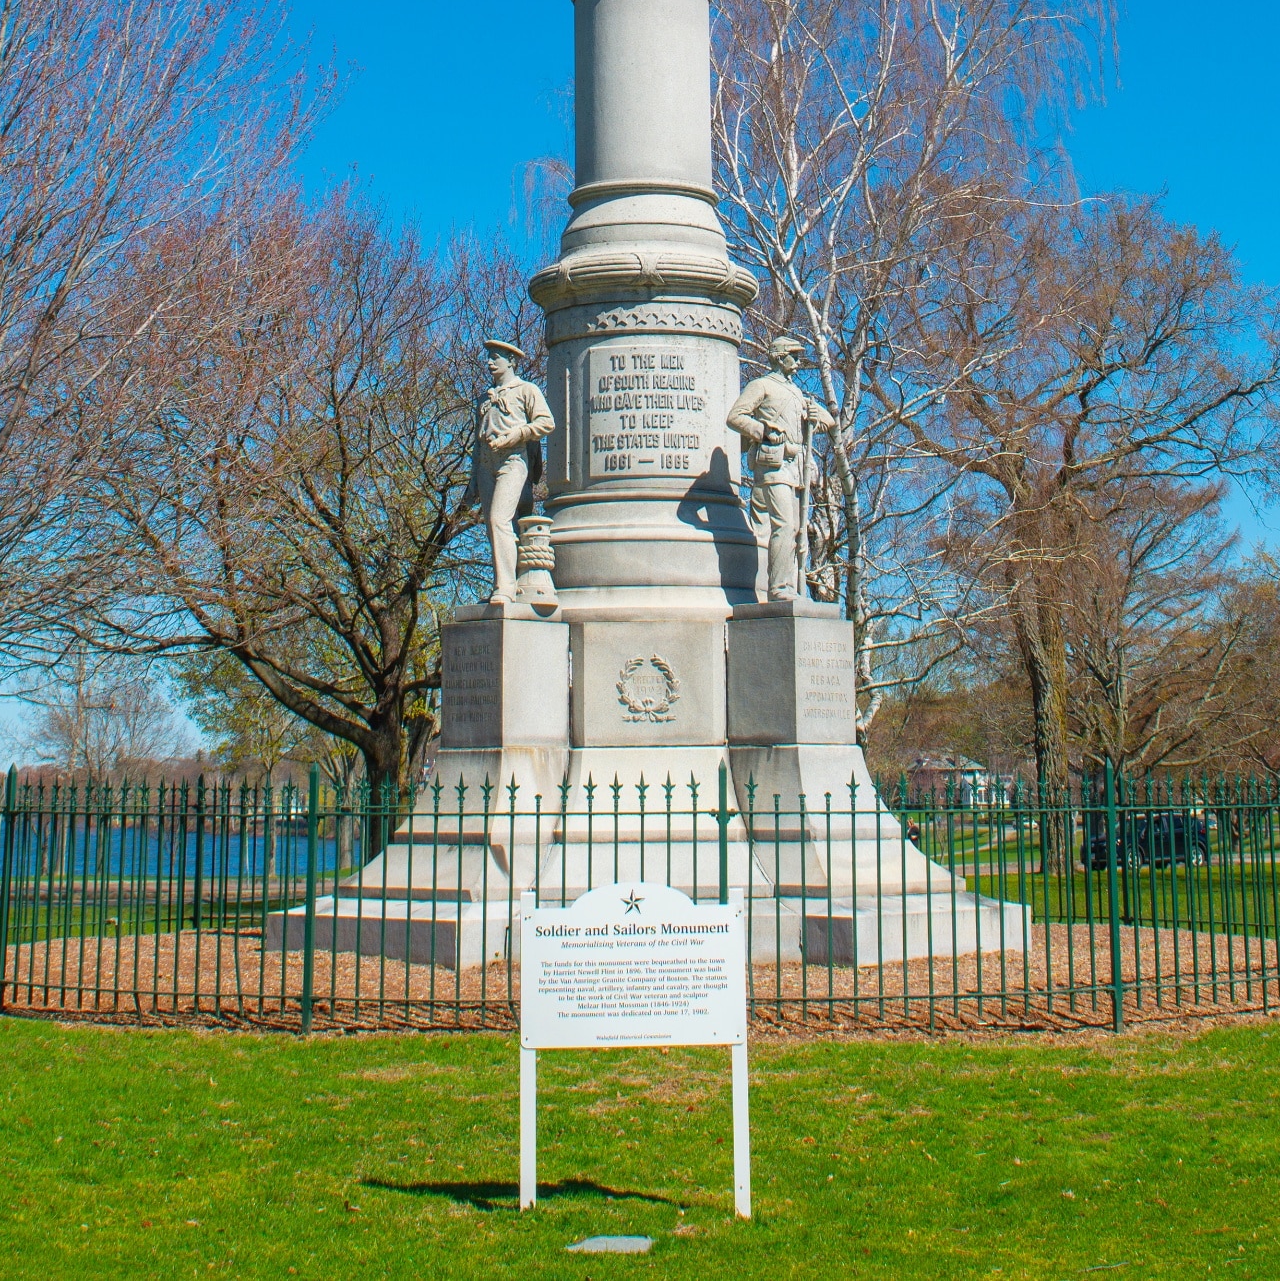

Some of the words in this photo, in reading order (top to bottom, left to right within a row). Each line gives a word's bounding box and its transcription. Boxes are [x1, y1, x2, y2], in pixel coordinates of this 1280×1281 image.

[610, 355, 626, 371] TO
[632, 355, 655, 369] THE
[661, 355, 684, 369] MEN
[599, 377, 613, 392] OF
[614, 375, 649, 389] SOUTH
[653, 376, 695, 390] READING
[591, 395, 612, 412] WHO
[615, 393, 642, 410] GAVE
[644, 394, 673, 409] THEIR
[677, 395, 704, 410] LIVES
[620, 415, 636, 429] TO
[643, 414, 674, 428] KEEP
[593, 435, 615, 451] THE
[617, 434, 660, 448] STATES
[664, 434, 700, 449] UNITED
[604, 454, 631, 471] 1861
[661, 454, 689, 469] 1865
[536, 925, 581, 937] Soldier
[585, 925, 608, 936] and
[614, 924, 656, 935] Sailors
[661, 923, 729, 934] Monument
[561, 941, 614, 949] Memorializing
[652, 958, 687, 966] bequeathed
[627, 975, 656, 983] Company
[622, 1009, 651, 1017] dedicated
